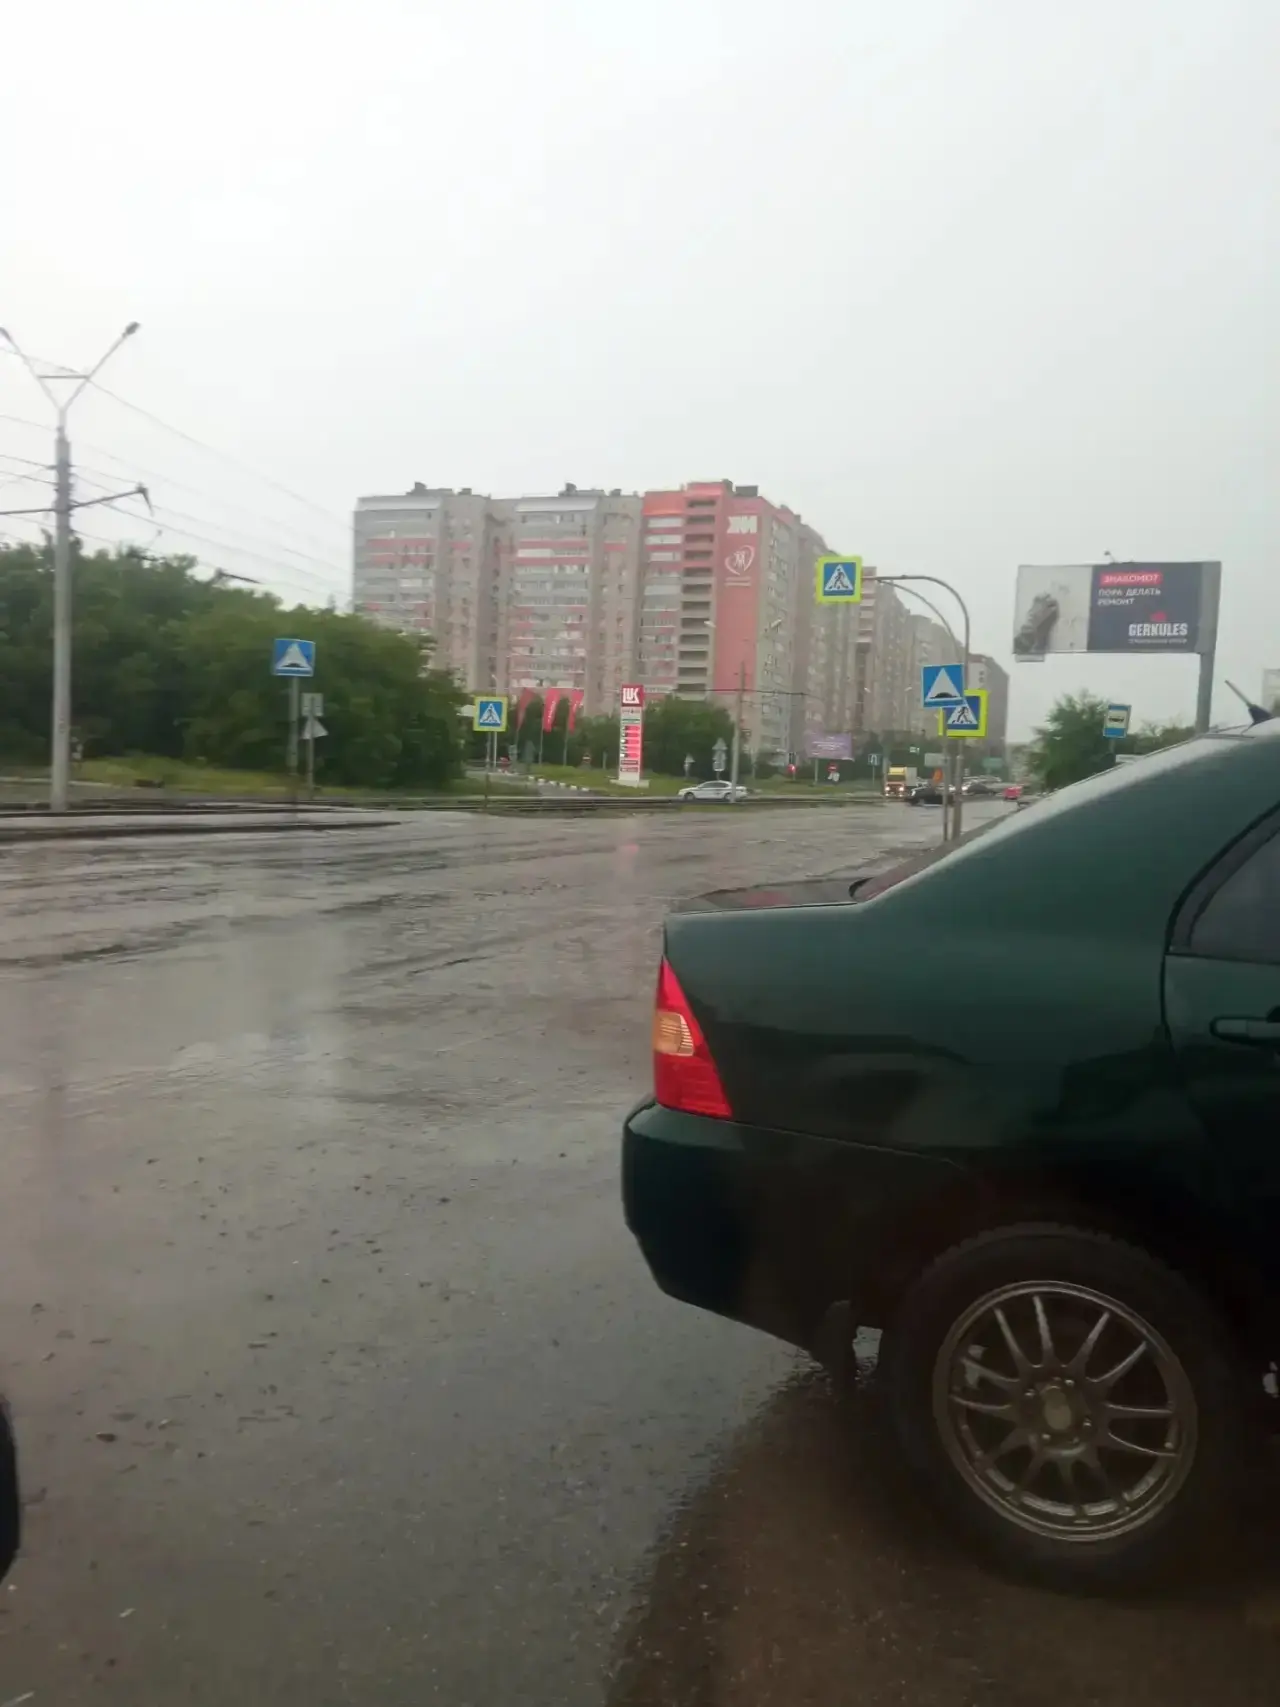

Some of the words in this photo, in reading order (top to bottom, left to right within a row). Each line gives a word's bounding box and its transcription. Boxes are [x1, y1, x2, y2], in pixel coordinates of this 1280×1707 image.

[1098, 588, 1122, 597] ПОРА
[1126, 587, 1161, 597] ДЕЛАТЬ
[1097, 598, 1135, 606] РЕМОНТ
[1128, 623, 1188, 636] GERKULES
